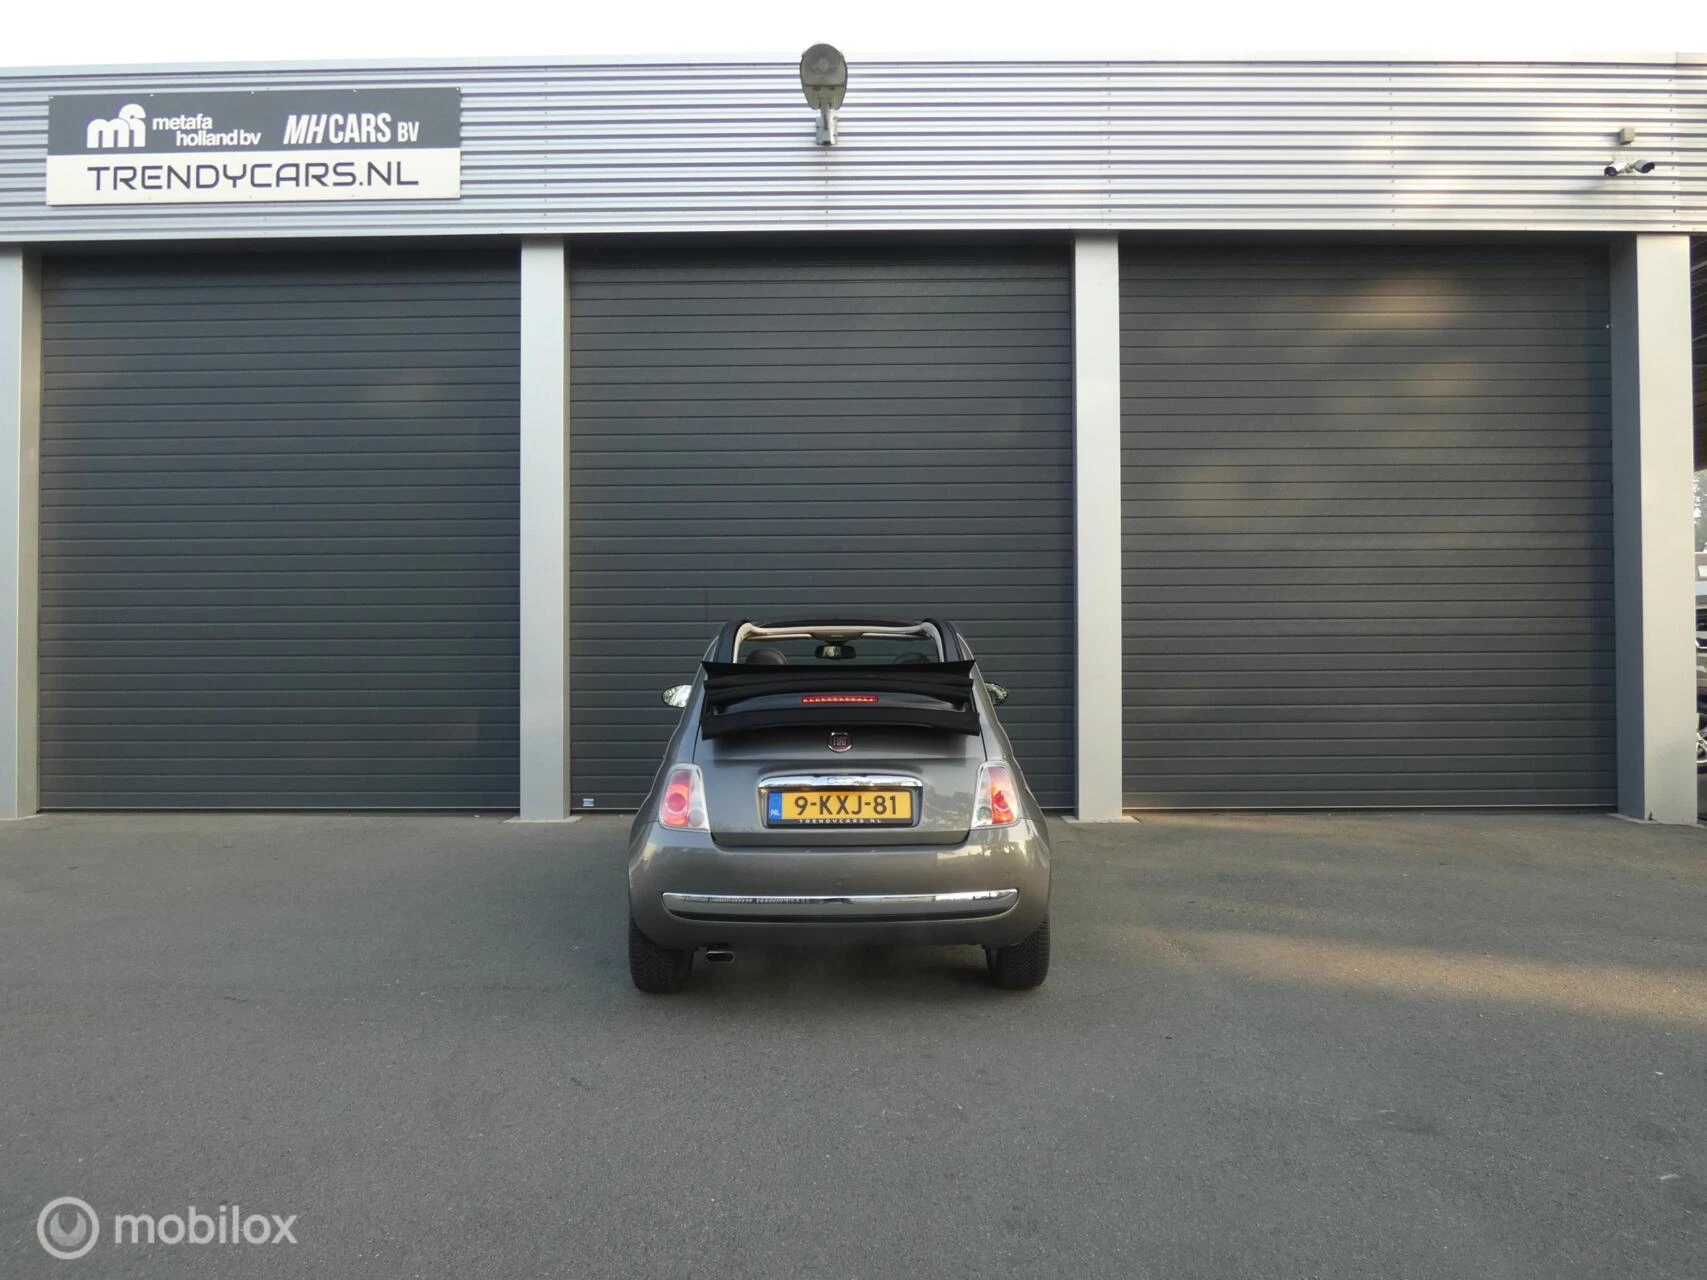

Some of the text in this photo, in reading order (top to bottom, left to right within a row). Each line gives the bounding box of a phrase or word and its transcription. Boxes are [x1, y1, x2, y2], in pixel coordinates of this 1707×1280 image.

[152, 112, 213, 130] metafa
[397, 121, 420, 142] BV
[87, 161, 419, 191] TRENDYCARS.NL
[770, 808, 781, 816] NL
[794, 795, 896, 815] 9-KXJ-81
